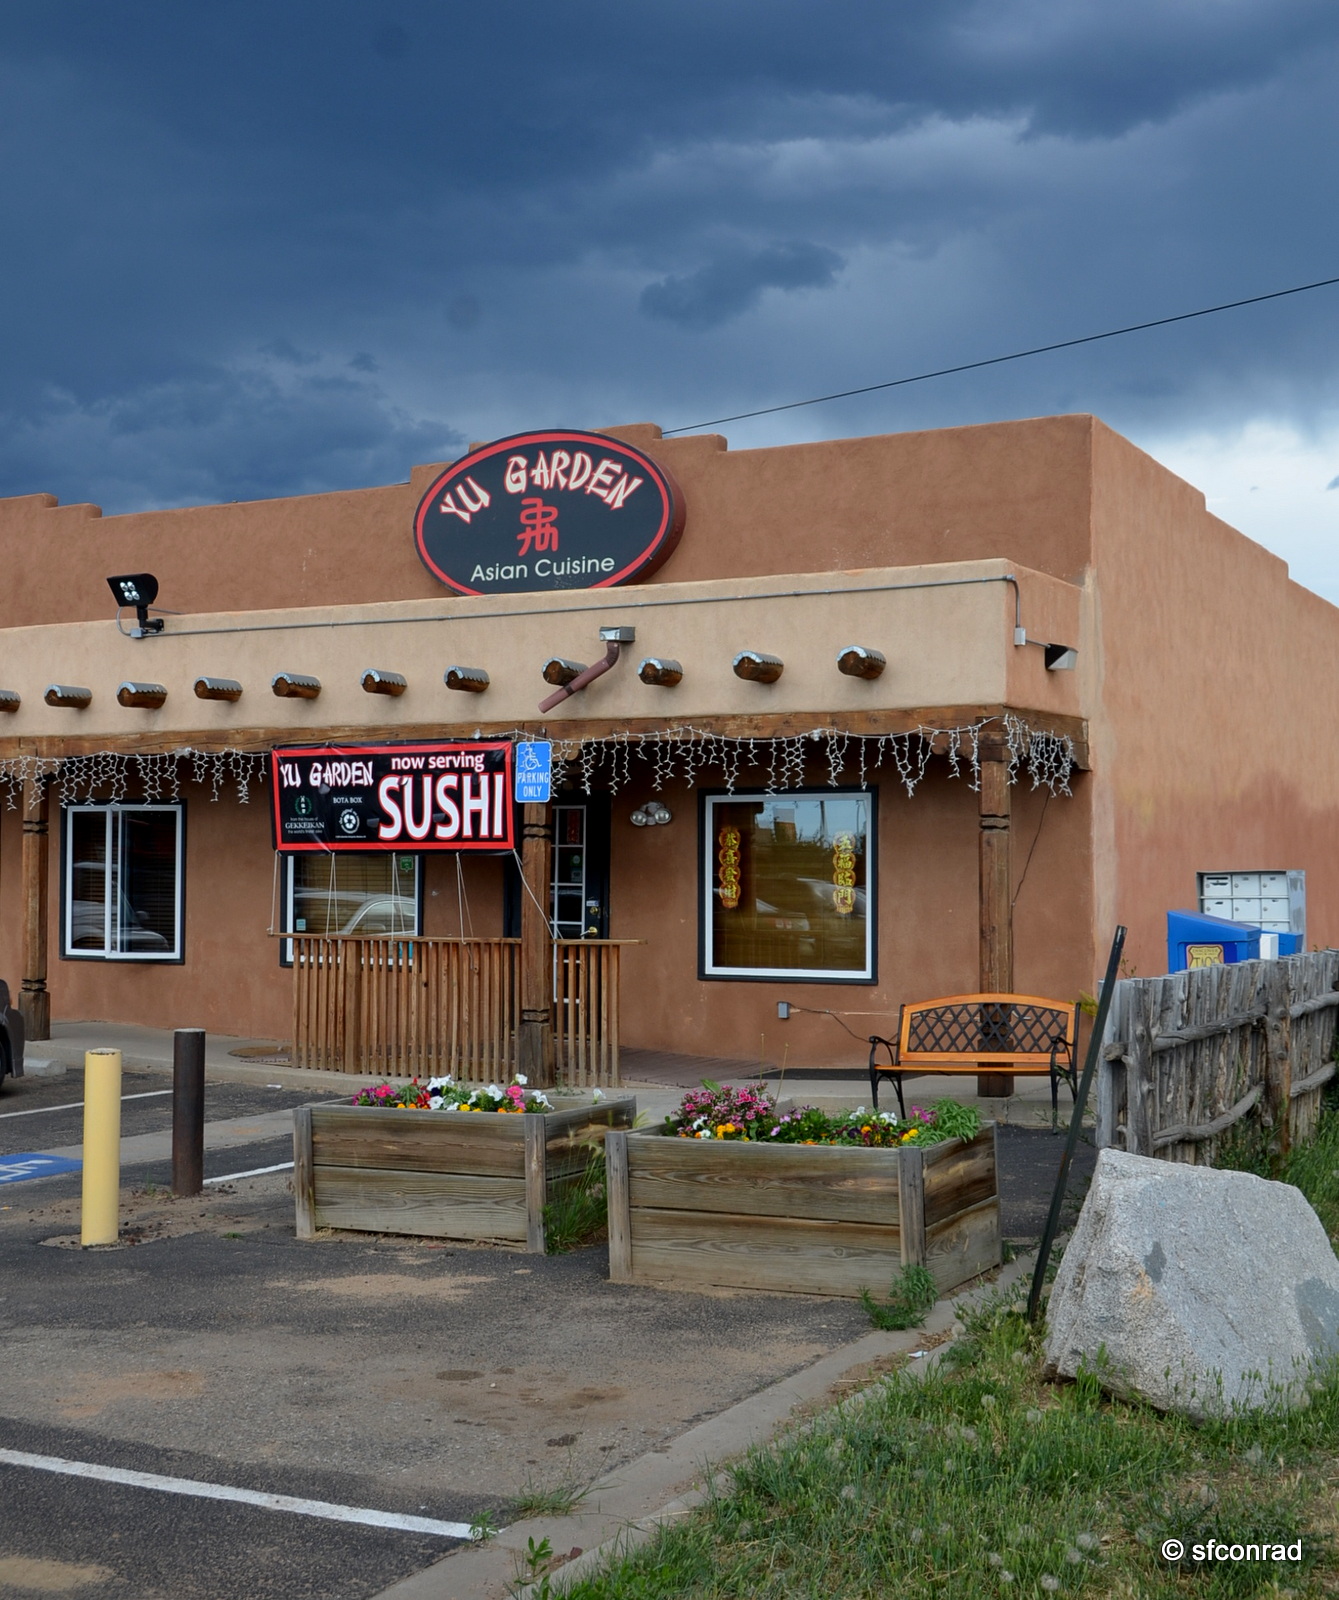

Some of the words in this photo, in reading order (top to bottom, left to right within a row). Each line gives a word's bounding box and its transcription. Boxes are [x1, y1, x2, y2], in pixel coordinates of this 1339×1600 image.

[439, 475, 491, 525] YU
[503, 448, 644, 511] GARDEN
[470, 562, 528, 583] Asian
[534, 555, 615, 577] Cuisine
[279, 762, 301, 789] YU
[309, 760, 374, 787] GARDEN
[391, 756, 426, 771] now
[428, 751, 485, 772] serving
[517, 772, 549, 784] PARKING
[523, 785, 542, 798] ONLY
[377, 771, 505, 841] SUSHI
